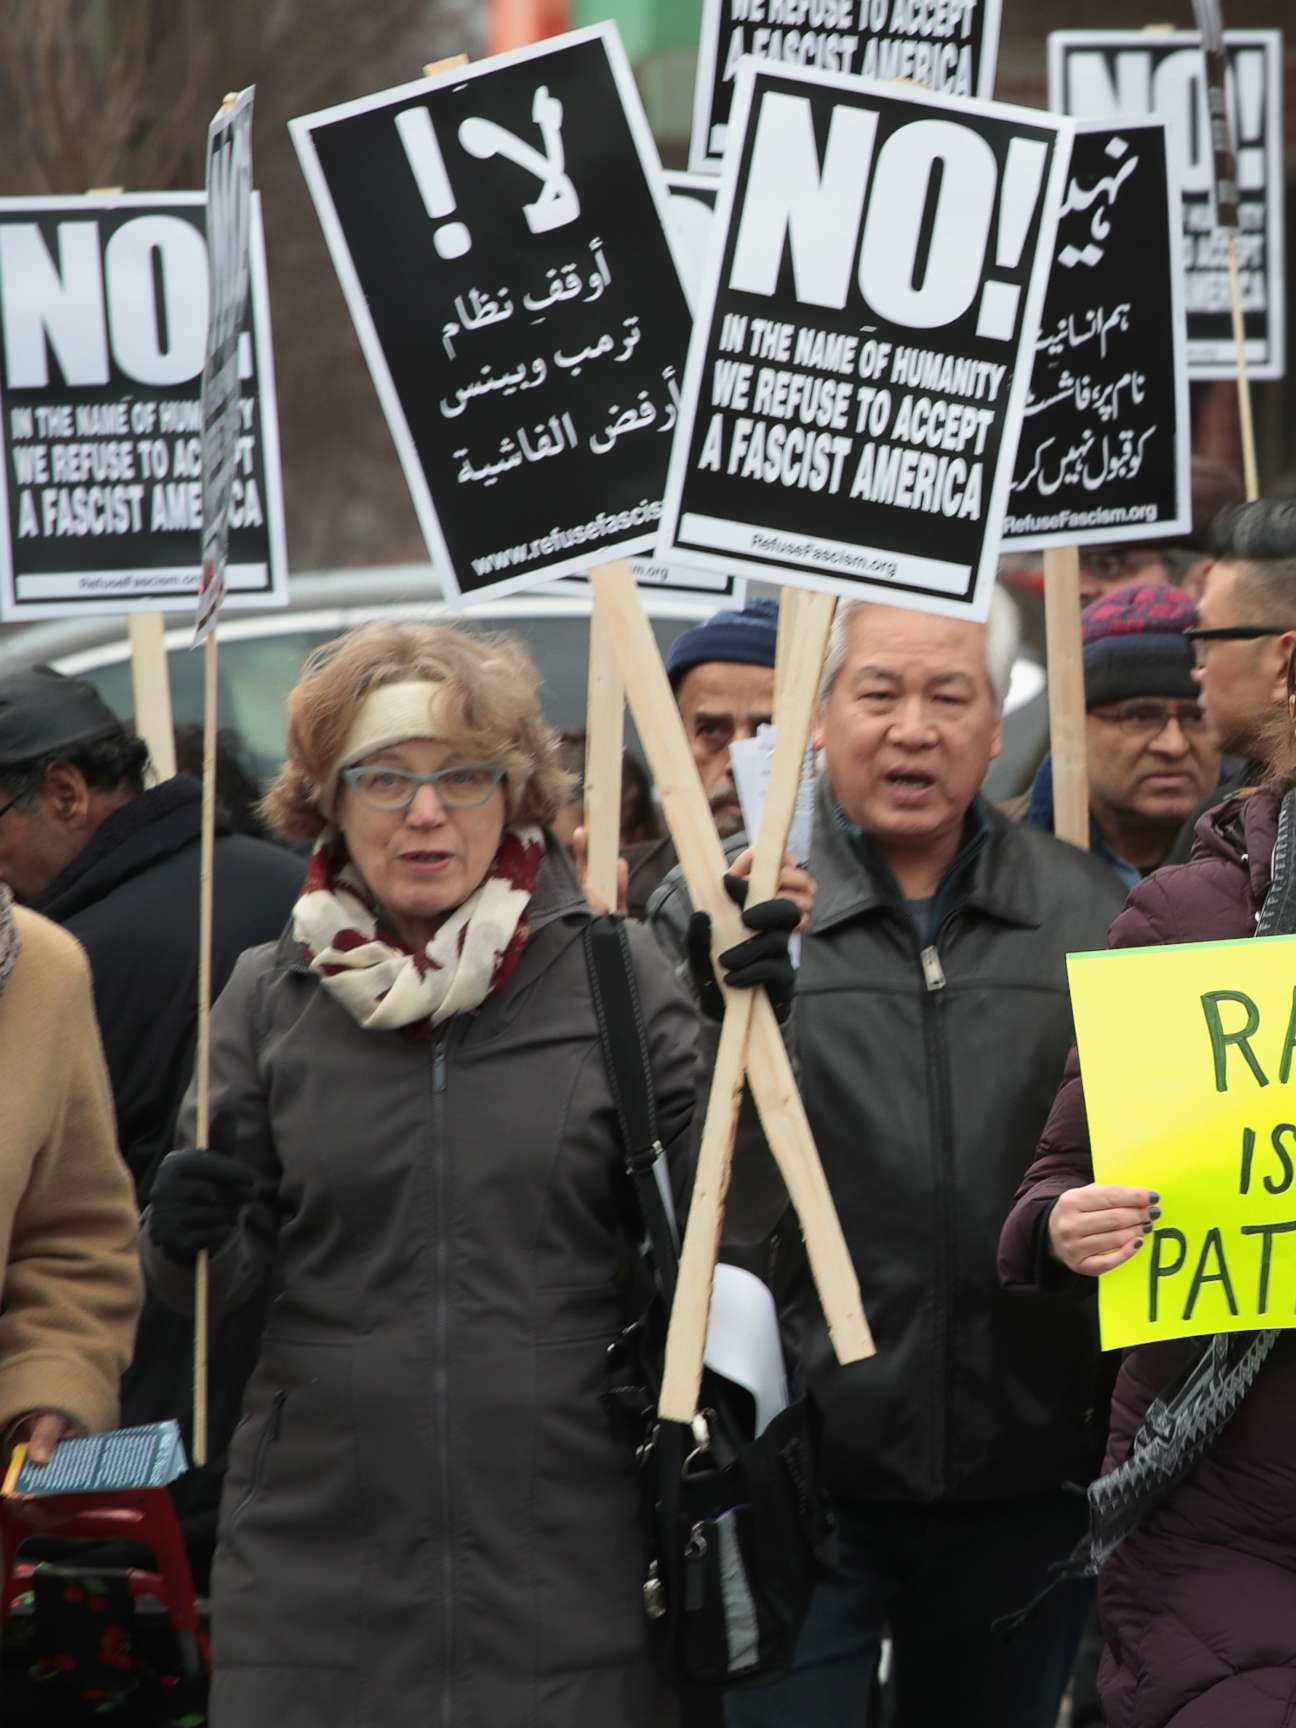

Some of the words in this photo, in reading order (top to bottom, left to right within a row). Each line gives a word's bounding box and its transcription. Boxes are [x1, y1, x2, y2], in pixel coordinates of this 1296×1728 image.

[889, 0, 977, 39] ACCEPT
[723, 26, 746, 82] A
[752, 28, 859, 74] FASCIST
[862, 36, 973, 97] AMERICA
[729, 91, 1049, 341] NO!
[441, 287, 514, 361] نظام
[553, 315, 641, 378] ترمب
[718, 313, 749, 354] IN
[750, 318, 796, 363] THE
[793, 326, 859, 375] NAME
[859, 339, 892, 380] OF
[890, 346, 1007, 402] HUMANITY
[11, 406, 33, 439] IN
[34, 404, 74, 439] THE
[75, 402, 130, 437] NAME
[131, 400, 157, 435] OF
[159, 397, 255, 433] HUMY
[589, 365, 682, 455] أرفض
[711, 358, 754, 410] WE
[752, 367, 853, 430] REFUSE
[856, 386, 892, 437] TO
[891, 394, 995, 456] ACCEPT
[12, 444, 49, 486] WE
[51, 440, 136, 484] REFUSE
[137, 438, 169, 480] TO
[172, 434, 256, 478] ACT
[452, 411, 579, 487] الفاشية
[697, 412, 724, 472] A
[727, 417, 853, 495] FASCIST
[849, 442, 984, 521] AMERICA
[18, 488, 39, 539] A
[42, 483, 145, 538] FASCIST
[151, 478, 263, 532] AMECA
[470, 498, 663, 577] www.refusefascis
[1003, 504, 1158, 534] RefuseFascism.org
[78, 573, 203, 591] RefuseFascism.or
[752, 533, 898, 578] RefuseFascism.org
